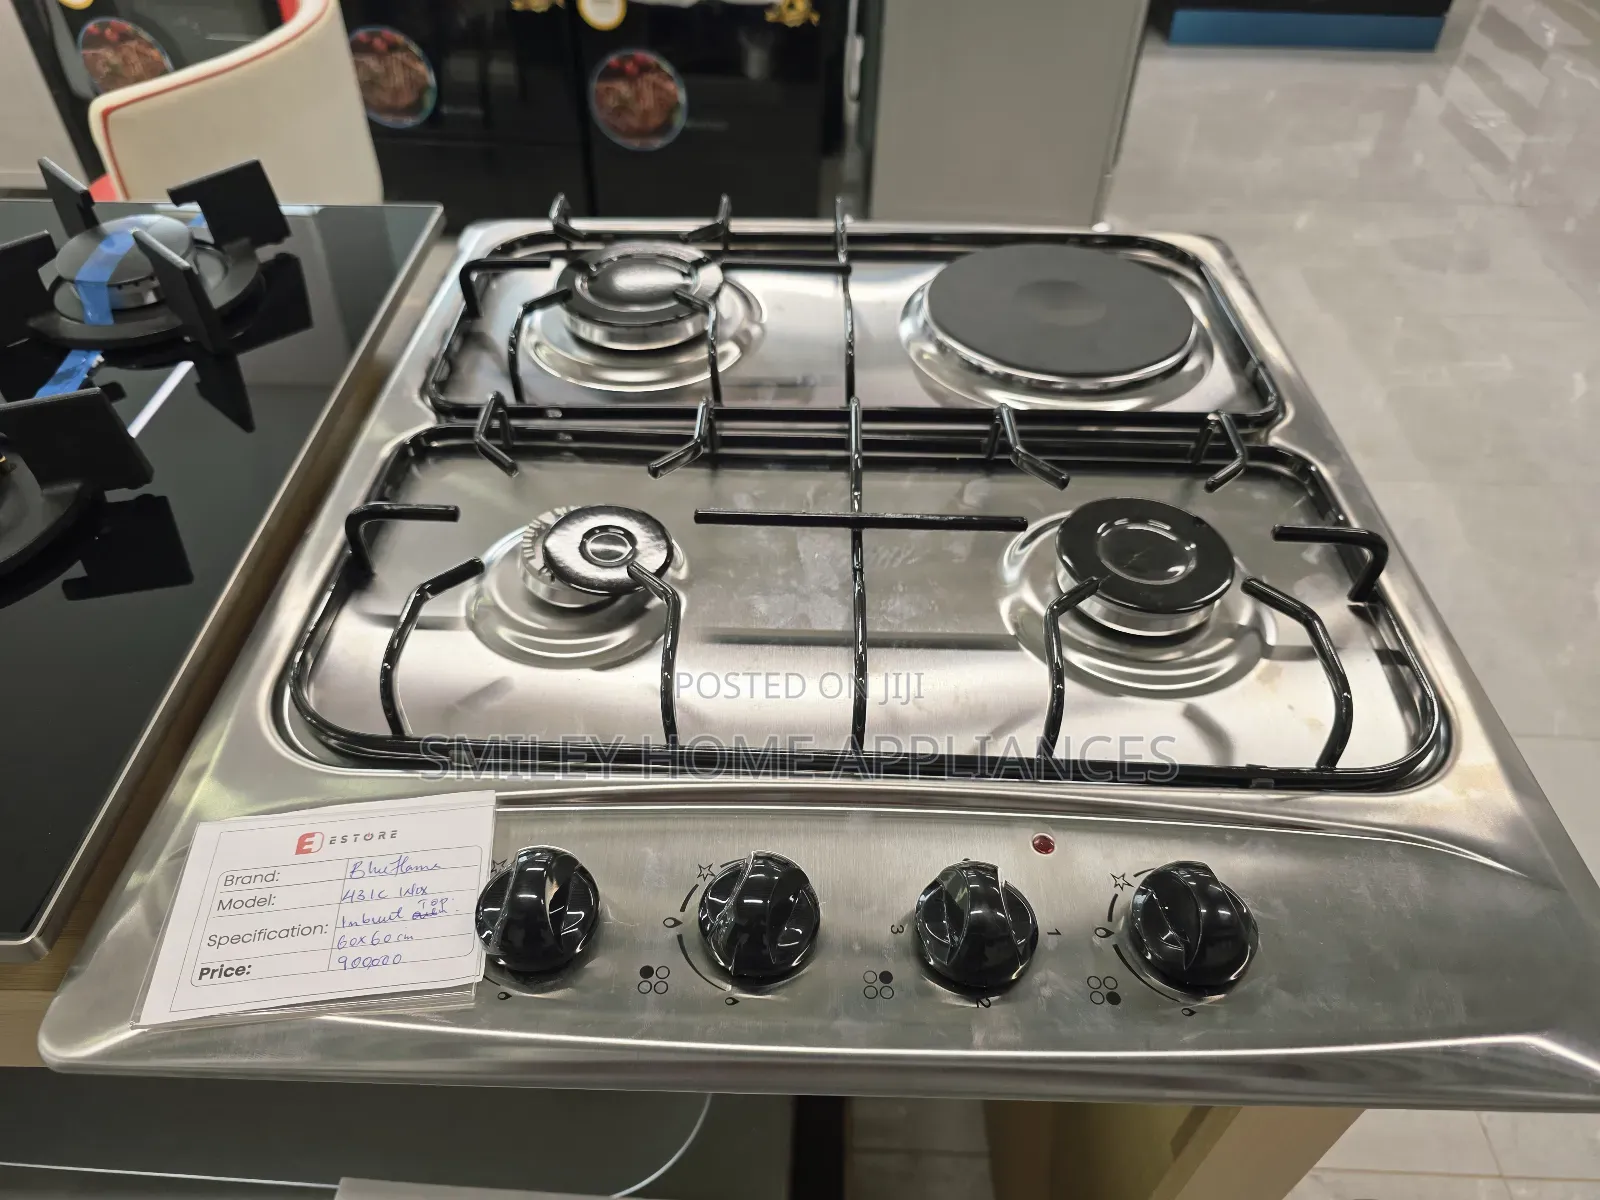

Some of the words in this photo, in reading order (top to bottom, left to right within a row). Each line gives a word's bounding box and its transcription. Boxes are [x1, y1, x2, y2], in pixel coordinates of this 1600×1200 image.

[329, 829, 398, 845] ESTORE
[223, 869, 281, 887] Brand:
[217, 893, 277, 912] Model:
[206, 923, 329, 950] Specification:
[197, 963, 253, 981] Price:
